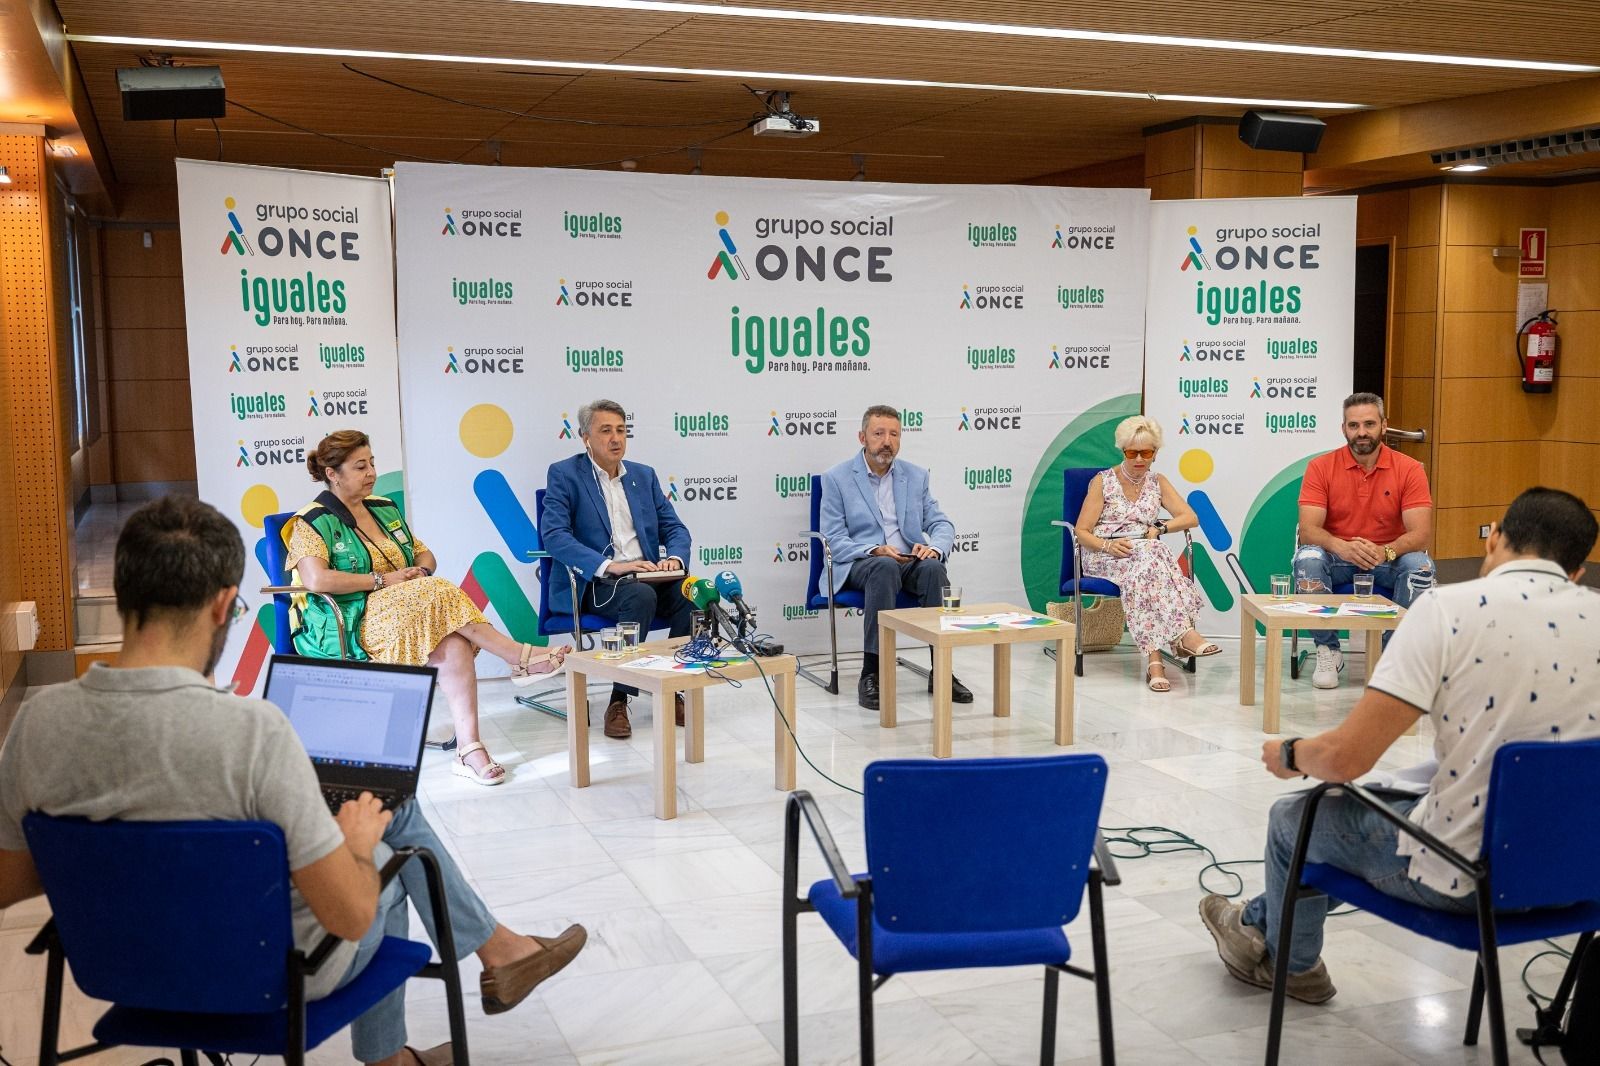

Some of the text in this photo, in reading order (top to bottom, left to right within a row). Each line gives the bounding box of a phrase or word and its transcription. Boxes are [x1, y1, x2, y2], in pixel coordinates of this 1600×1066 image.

[256, 203, 358, 223] grupo social
[462, 210, 521, 219] grupo social
[462, 221, 522, 237] ONCE
[564, 211, 622, 238] iguales
[755, 216, 893, 239] grupo social
[1068, 225, 1115, 234] grupo social
[968, 223, 1017, 247] iguales
[1216, 223, 1320, 242] grupo social
[258, 227, 359, 261] ONCE
[1067, 236, 1115, 249] ONCE
[755, 244, 893, 282] ONCE
[1215, 245, 1320, 270] ONCE
[453, 277, 513, 305] iguales
[575, 281, 632, 290] grupo social
[976, 285, 1024, 294] grupo social
[241, 268, 346, 326] iguales
[576, 292, 632, 307] ONCE
[976, 295, 1023, 309] ONCE
[1058, 285, 1104, 309] iguales
[1197, 280, 1301, 325] iguales
[273, 316, 348, 326] Para hoy. Para mañana.
[1223, 316, 1301, 325] Para hoy. Para mañana.
[731, 306, 871, 374] iguales
[1196, 340, 1220, 348] grupo
[246, 344, 298, 355] grupo social
[320, 343, 365, 369] iguales
[464, 346, 524, 356] grupo social
[1065, 345, 1110, 354] grupo social
[1196, 349, 1245, 361] ONCE
[1267, 338, 1318, 360] iguales
[247, 357, 299, 372] ONCE
[566, 346, 623, 373] iguales
[968, 345, 1015, 370] iguales
[1064, 356, 1110, 368] ONCE
[464, 358, 524, 373] ONCE
[768, 360, 871, 374] Para hoy. Para mañana.
[1179, 377, 1228, 398] iguales
[1267, 376, 1318, 385] grupo social
[323, 389, 367, 400] grupo social
[1266, 386, 1316, 398] ONCE
[231, 392, 286, 420] iguales
[324, 401, 368, 416] ONCE
[974, 405, 1021, 416] grupo social
[785, 410, 837, 420] grupo social
[1266, 411, 1316, 434] iguales
[674, 412, 728, 437] iguales
[785, 422, 837, 436] ONCE
[974, 417, 1021, 430] ONCE
[1194, 423, 1244, 434] ONCE
[254, 436, 305, 449] grupo social
[255, 448, 305, 465] ONCE
[684, 475, 738, 486] grupo social
[776, 473, 810, 498] igual
[965, 466, 1012, 490] iguales
[683, 487, 737, 501] ONCE
[961, 531, 979, 539] social
[951, 541, 979, 552] NCE
[699, 545, 742, 566] iguales
[788, 550, 809, 561] ON
